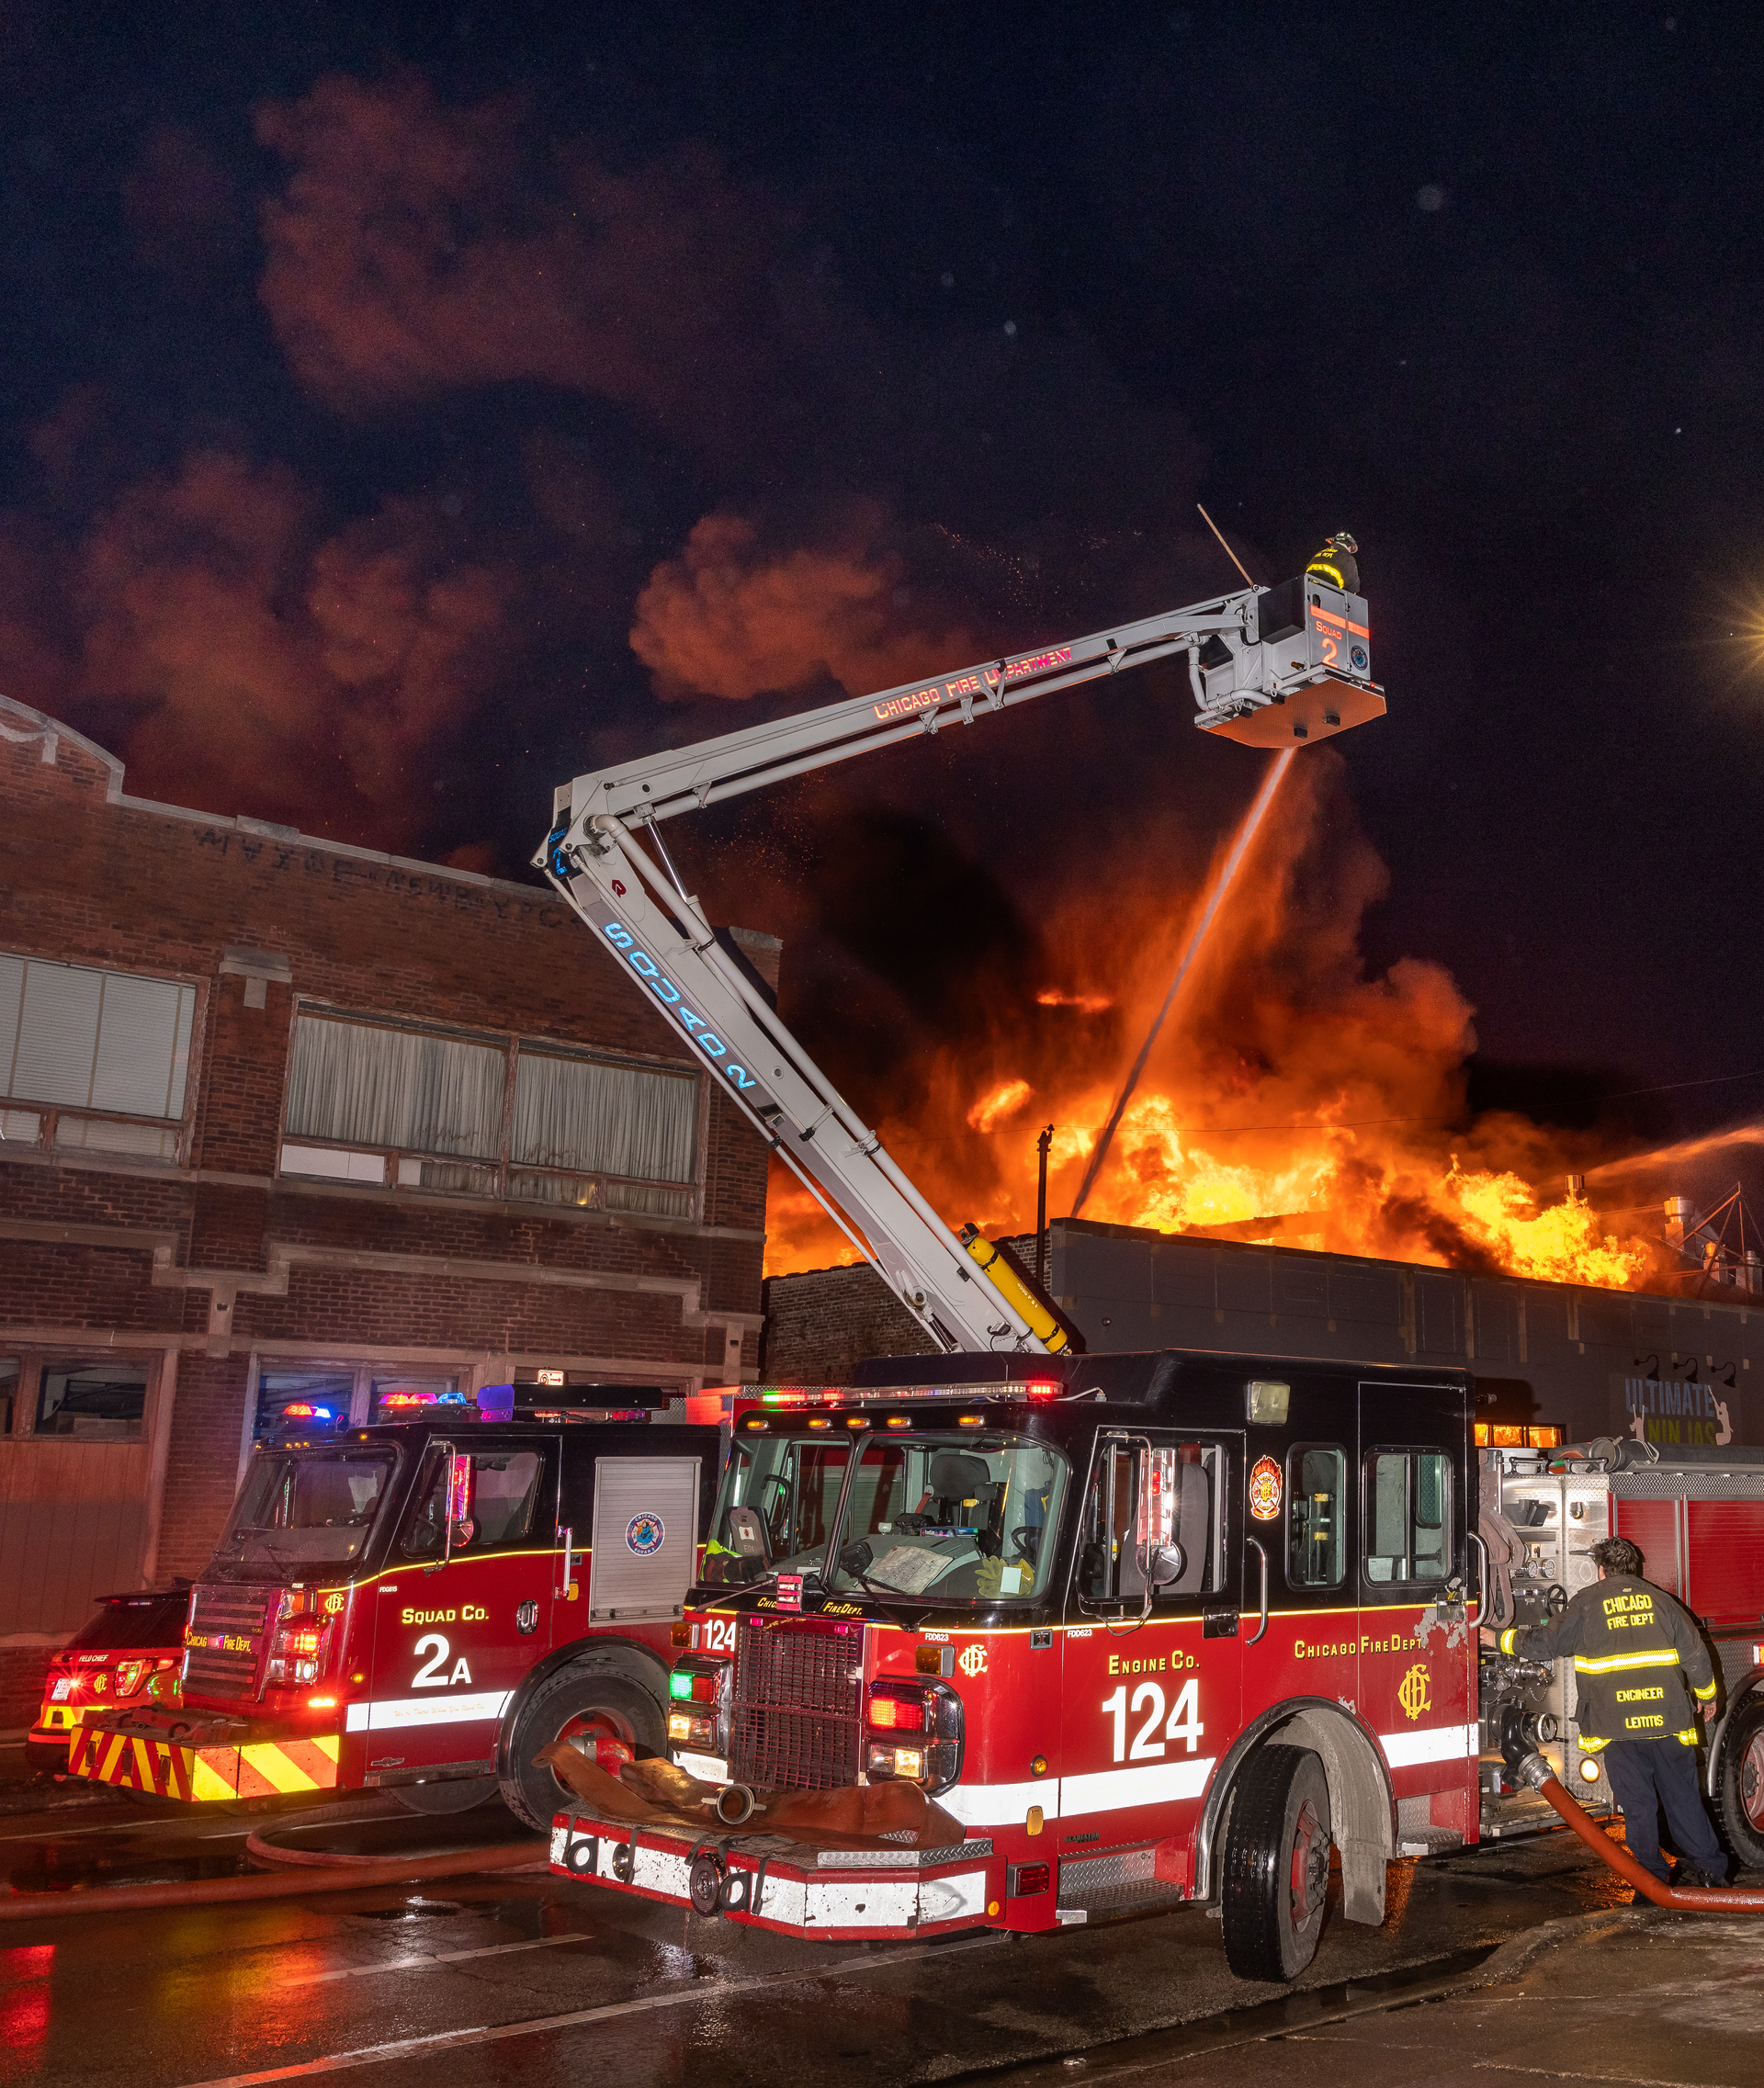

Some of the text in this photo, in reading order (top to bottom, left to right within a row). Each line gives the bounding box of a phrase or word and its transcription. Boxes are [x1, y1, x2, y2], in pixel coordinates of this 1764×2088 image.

[1316, 620, 1342, 640] SQUAD
[1321, 638, 1339, 669] 2
[874, 647, 1073, 719] CHICAGO FIRE DPARTMENT
[552, 847, 568, 875] 2
[604, 922, 756, 1089] SQUAD 2
[1624, 1378, 1715, 1417] ULTIMATE
[757, 1597, 776, 1608] CHIC
[822, 1601, 842, 1613] FIRE
[1602, 1594, 1653, 1615] CHICAGO
[401, 1608, 456, 1625] SQUAD
[1607, 1612, 1654, 1631] FIRE DEPT
[186, 1631, 208, 1648] CHICAG
[704, 1619, 737, 1653] 124
[924, 1632, 949, 1642] FDD623
[1067, 1629, 1092, 1638] FDD623
[1295, 1640, 1356, 1659] CHICAGO
[1361, 1635, 1389, 1653] FIRE
[1108, 1650, 1200, 1676] ENGINE CO.
[1615, 1687, 1664, 1703] ENGINEER
[1102, 1678, 1204, 1763] 124
